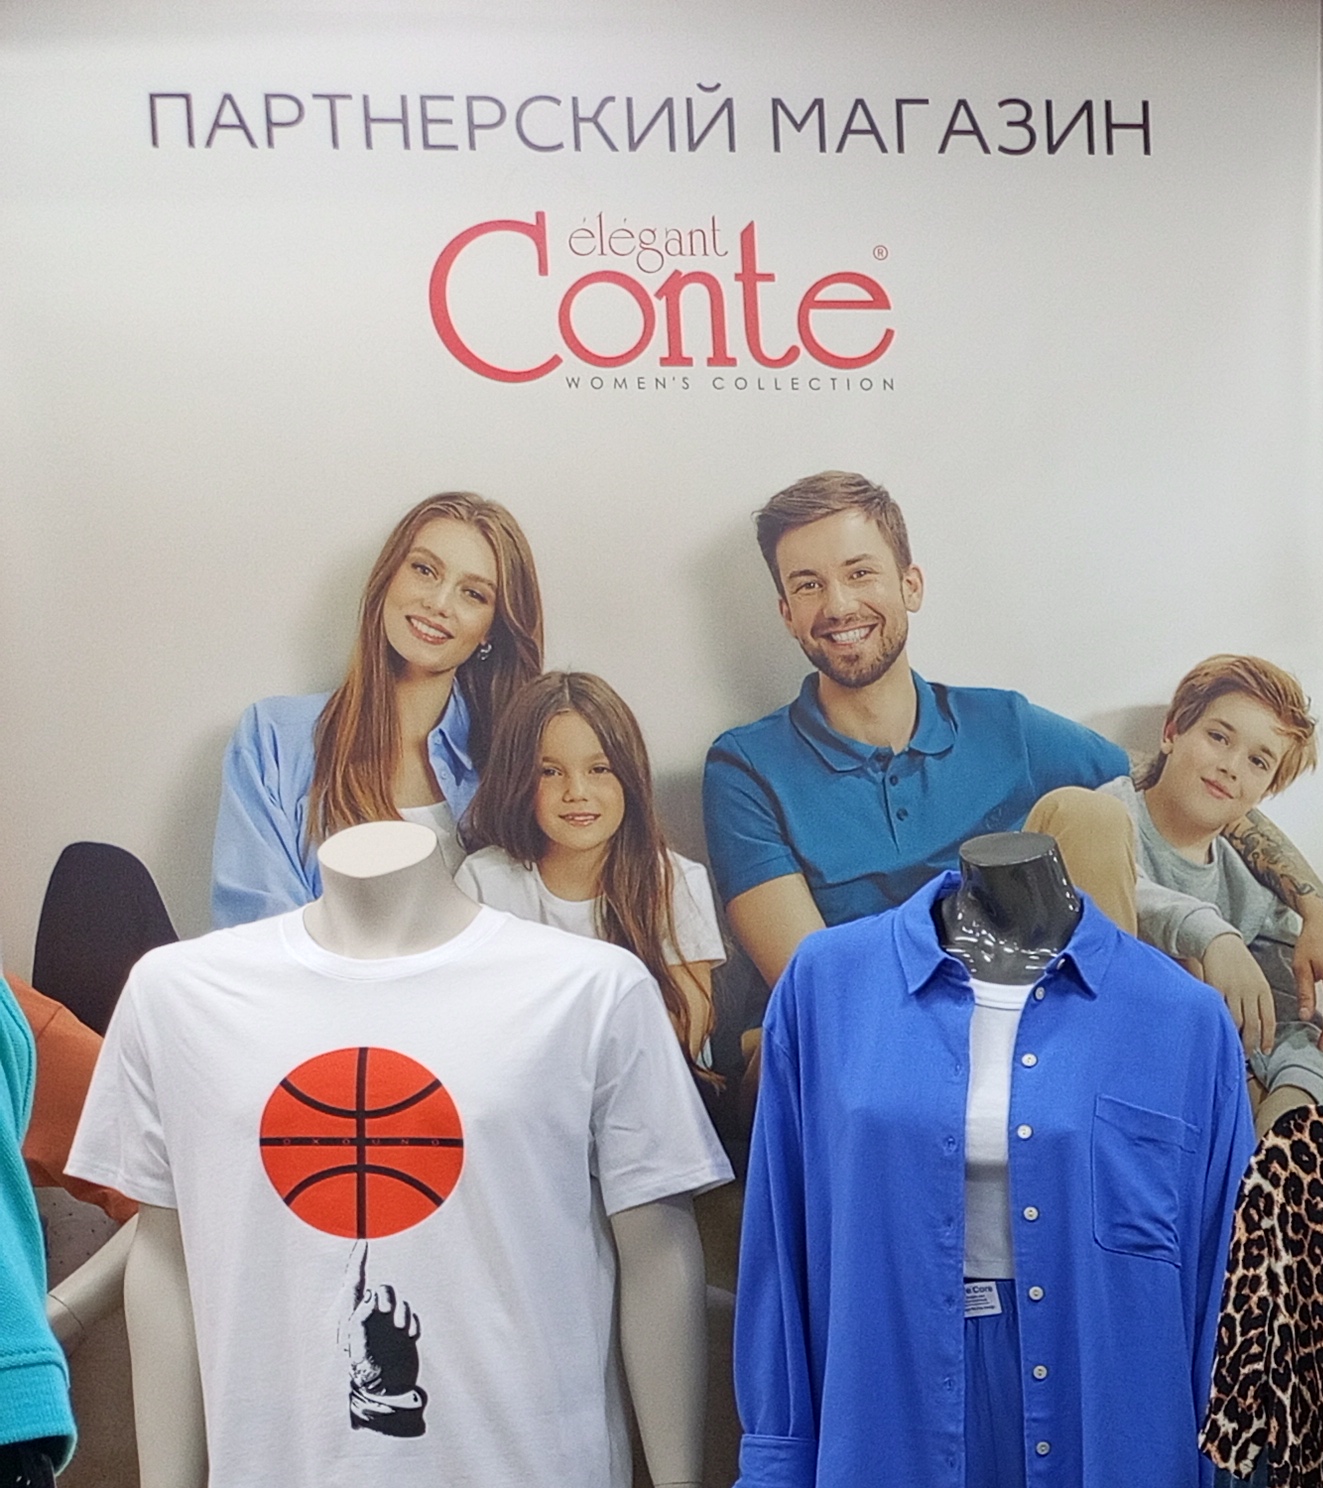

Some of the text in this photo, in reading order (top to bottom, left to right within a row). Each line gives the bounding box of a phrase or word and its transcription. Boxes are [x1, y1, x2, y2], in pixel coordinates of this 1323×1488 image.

[147, 82, 1153, 156] ПАРТНЕРСКИЙ МАГАЗИН
[568, 212, 729, 273] élégant
[428, 211, 896, 385] Conte
[565, 375, 898, 392] WOMEN'S COLLECTION
